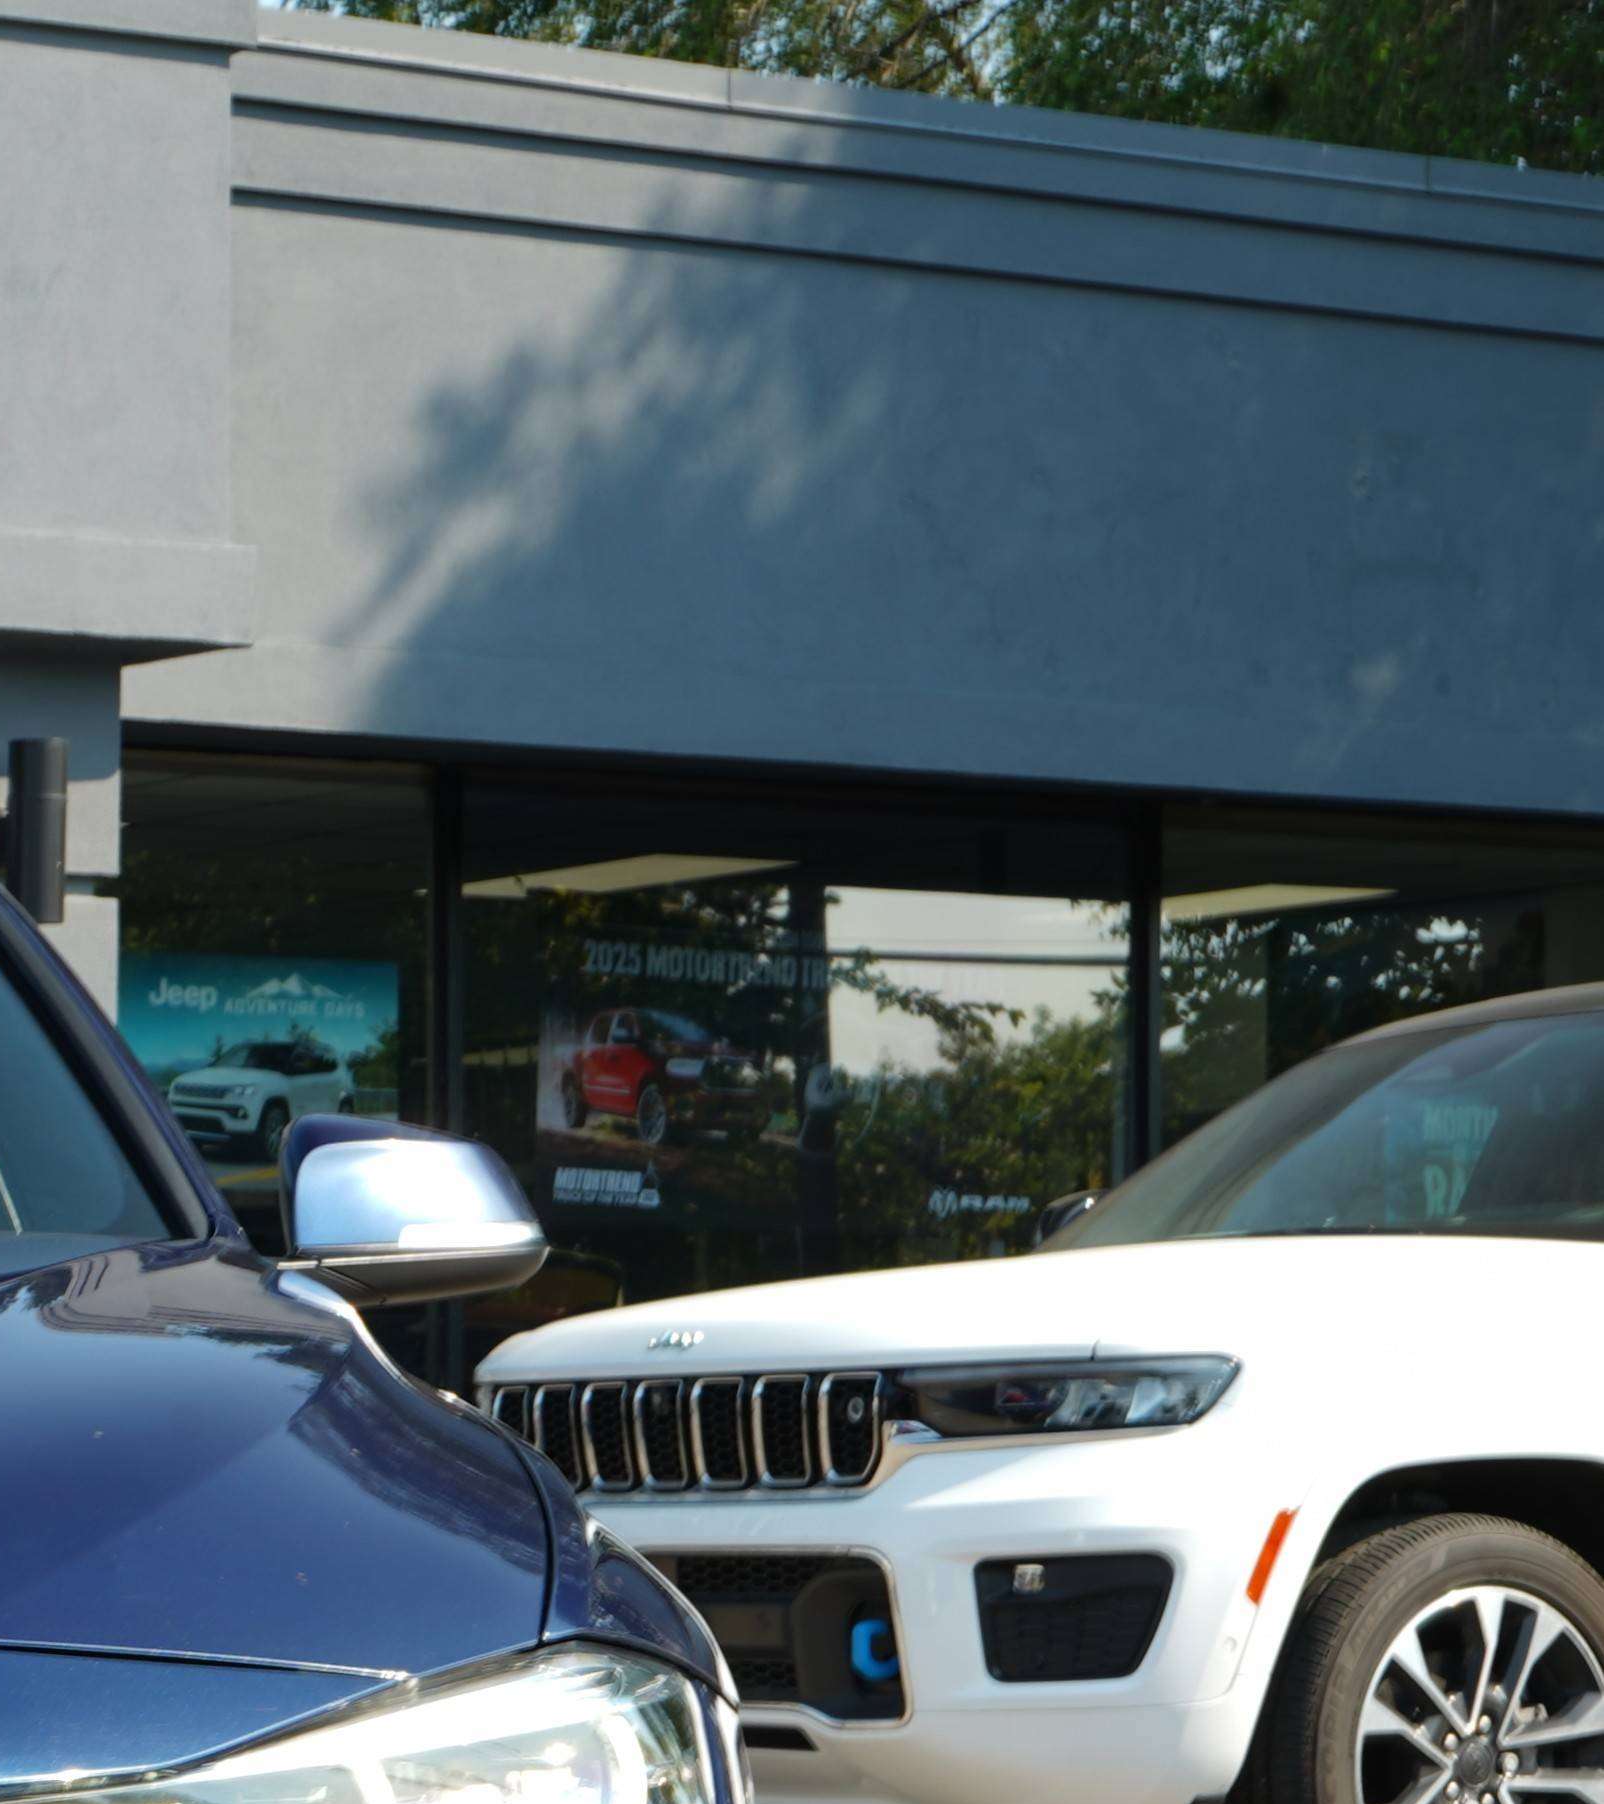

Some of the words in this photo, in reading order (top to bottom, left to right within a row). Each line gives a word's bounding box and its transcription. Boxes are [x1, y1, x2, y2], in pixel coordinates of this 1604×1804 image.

[585, 939, 642, 977] 2025
[148, 977, 219, 1012] Jeep
[224, 999, 318, 1015] ADVENTURE
[324, 1001, 366, 1018] DAYS
